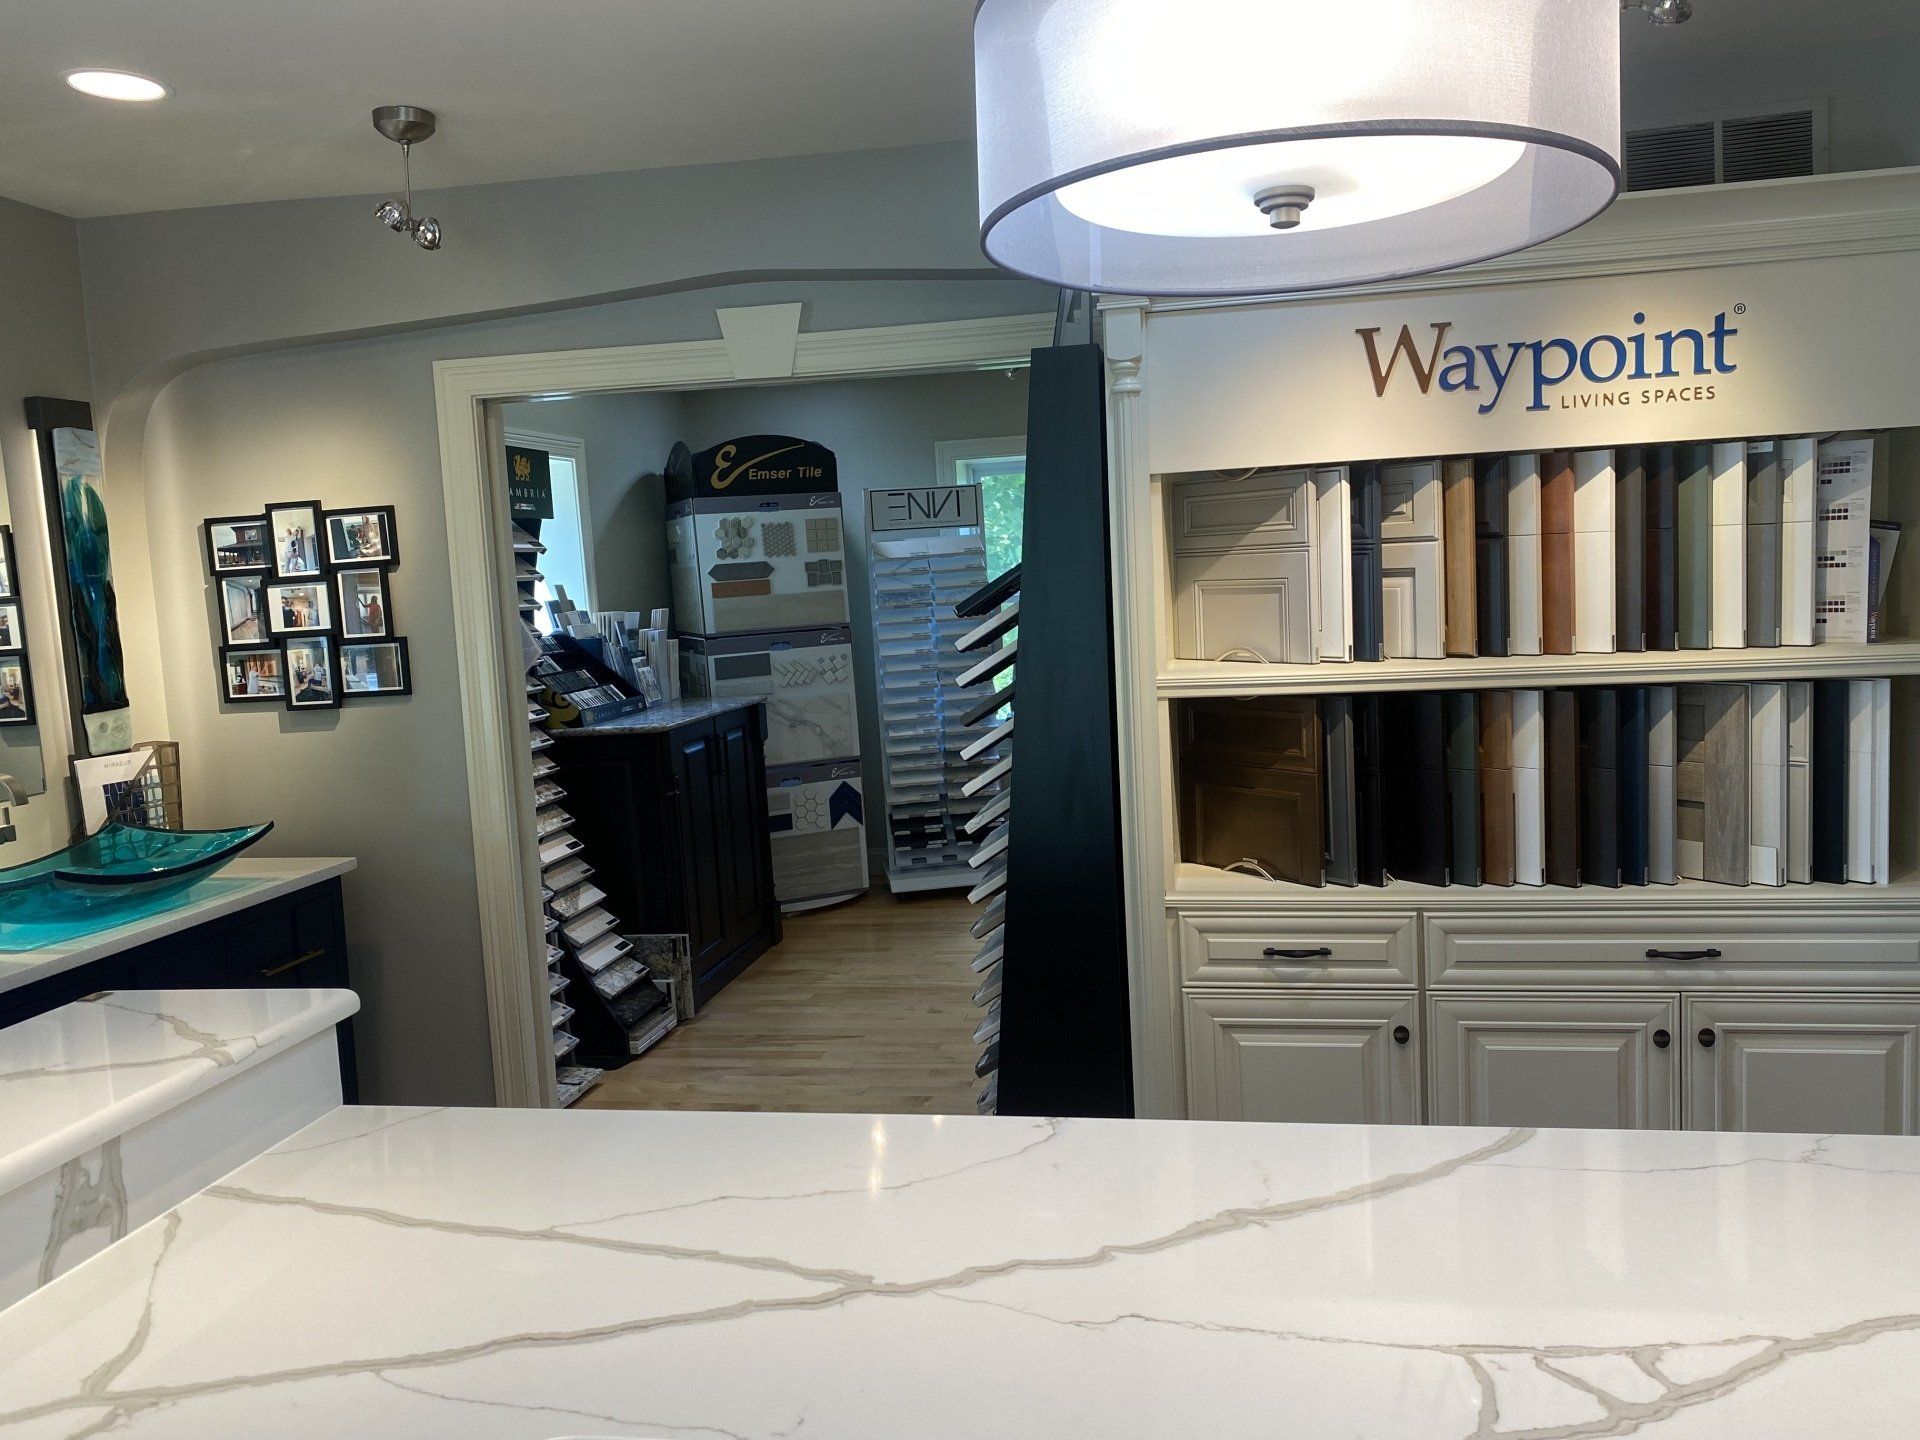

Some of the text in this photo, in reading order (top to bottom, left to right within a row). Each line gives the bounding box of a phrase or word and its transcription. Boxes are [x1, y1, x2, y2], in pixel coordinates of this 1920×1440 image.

[1560, 385, 1716, 409] LIVING SPACES
[748, 466, 823, 480] Emser Tile
[509, 487, 546, 499] AMBRIA
[888, 489, 961, 522] ENVI
